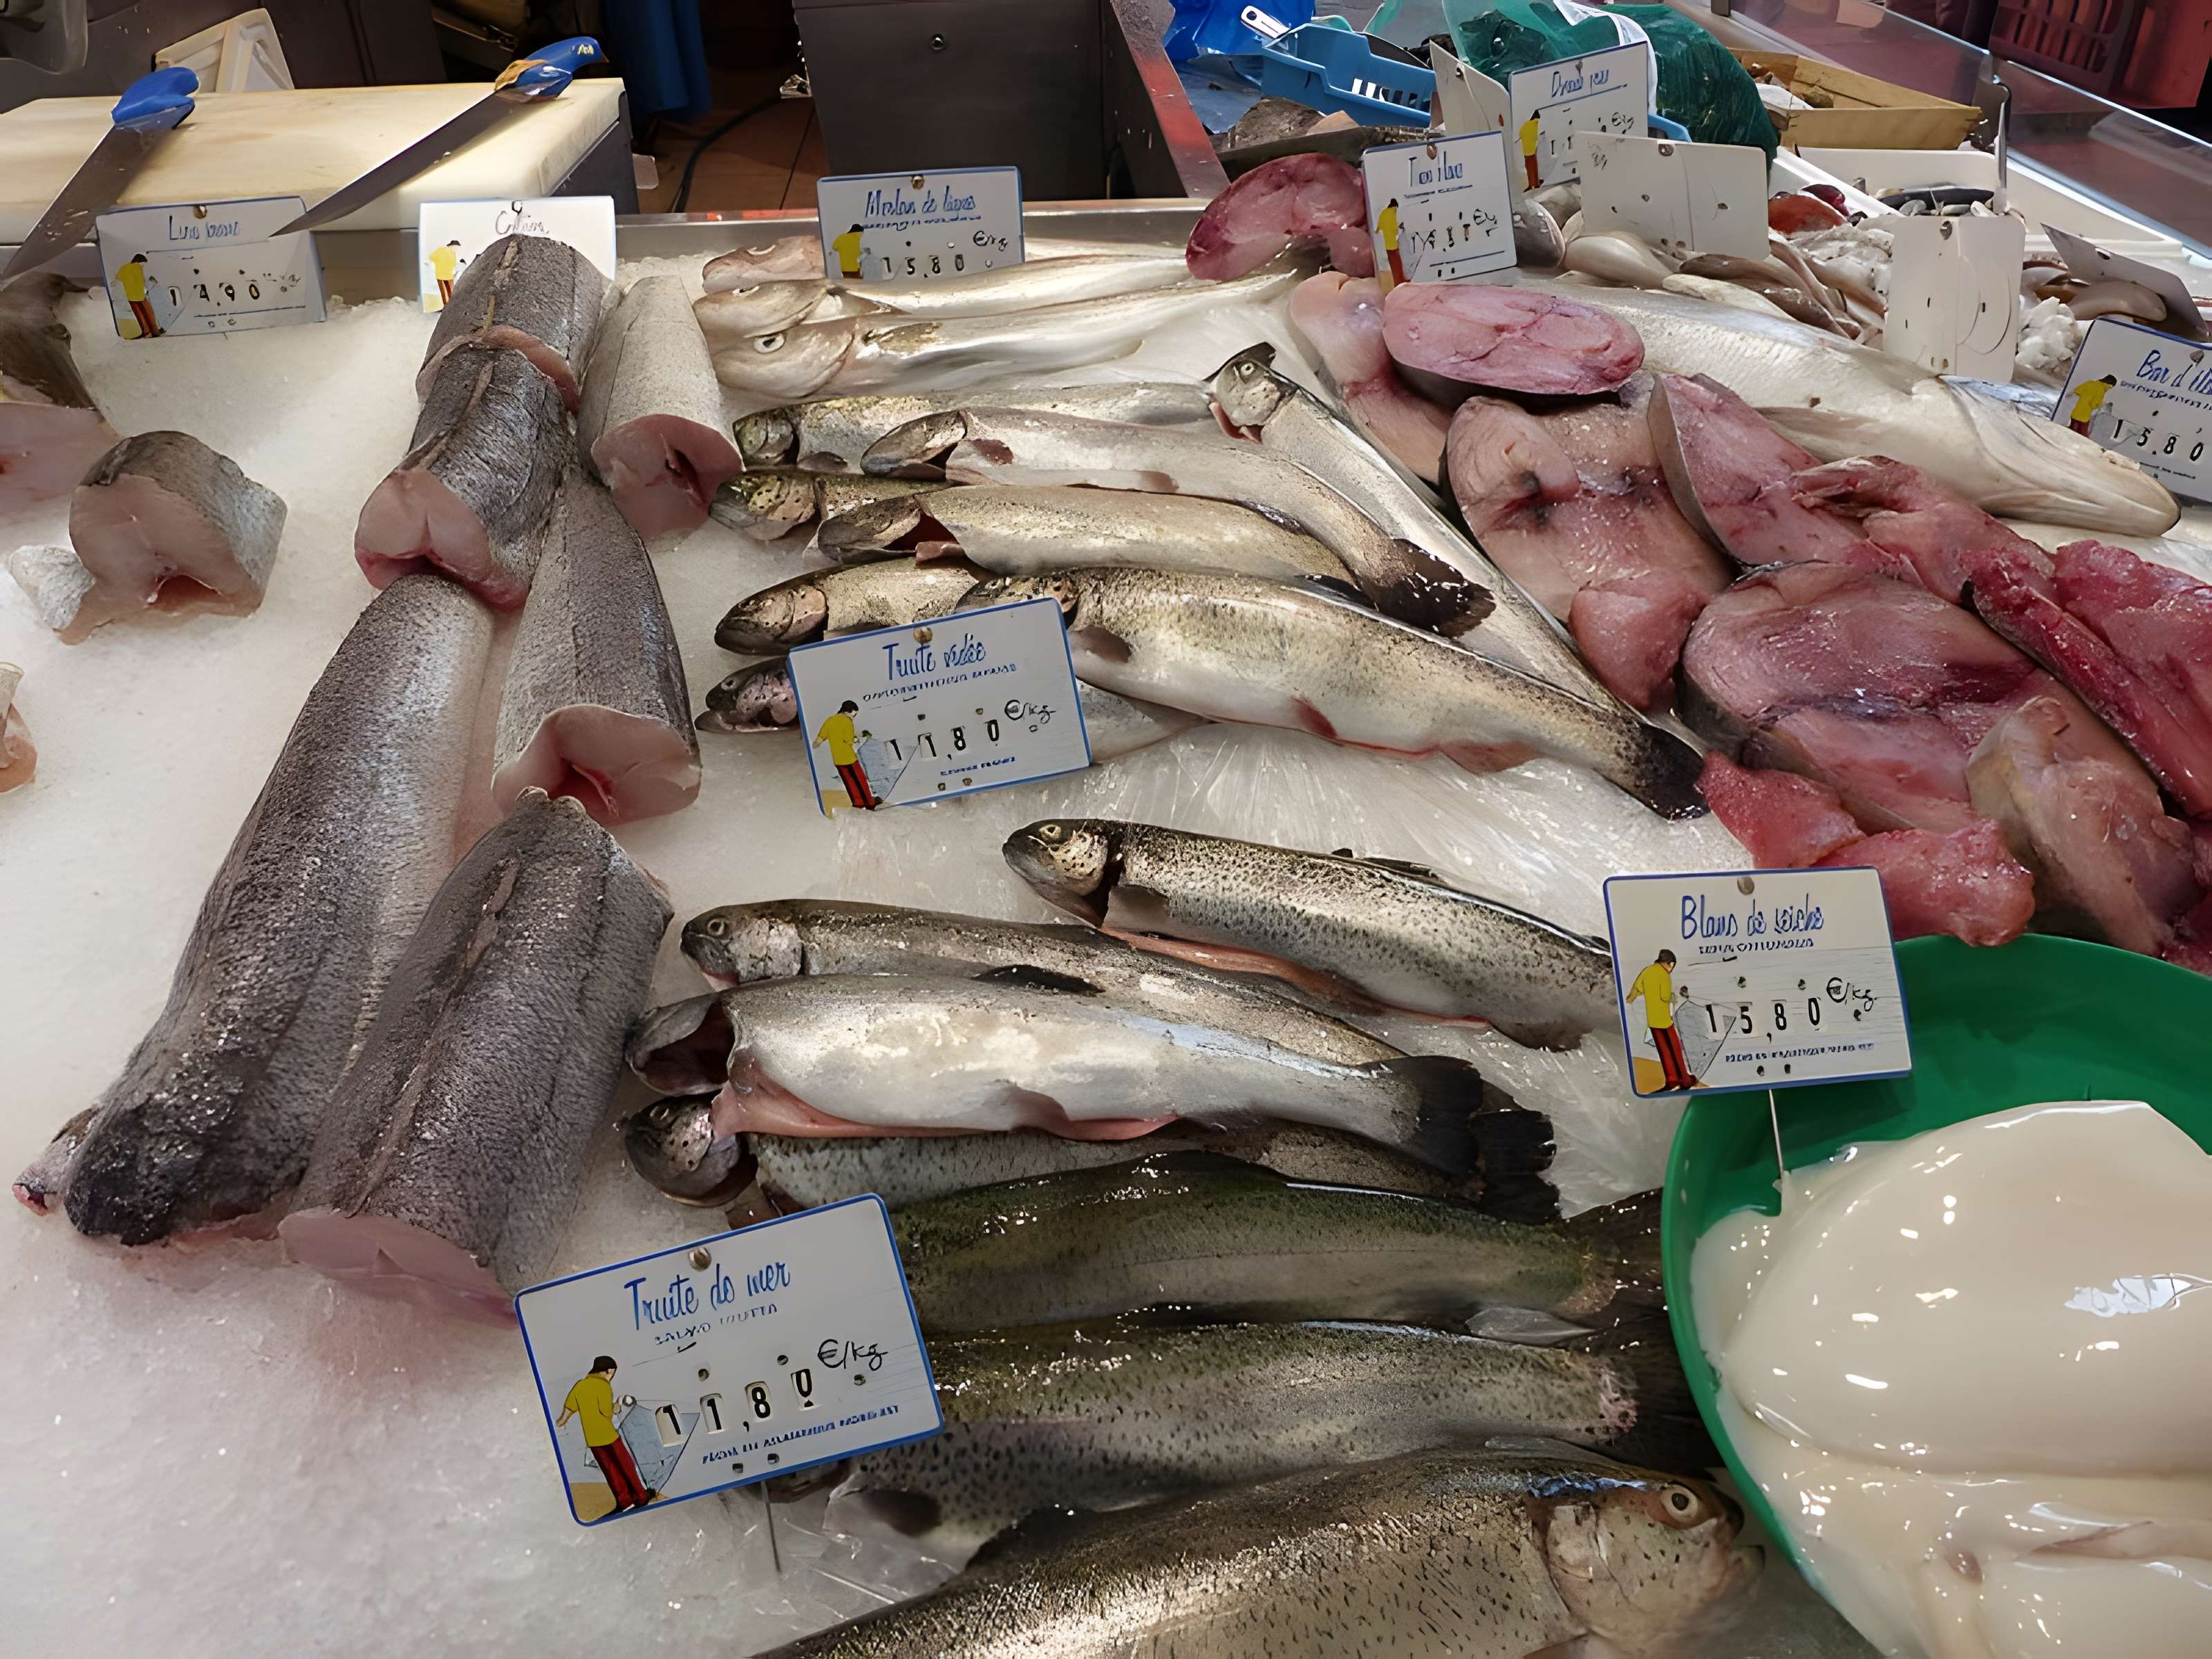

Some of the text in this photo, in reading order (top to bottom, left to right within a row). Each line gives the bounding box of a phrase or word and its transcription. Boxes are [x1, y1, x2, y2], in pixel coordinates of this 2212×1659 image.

[624, 1274, 699, 1338] Truite
[747, 1262, 791, 1297] mer
[817, 1338, 889, 1371] €/kg
